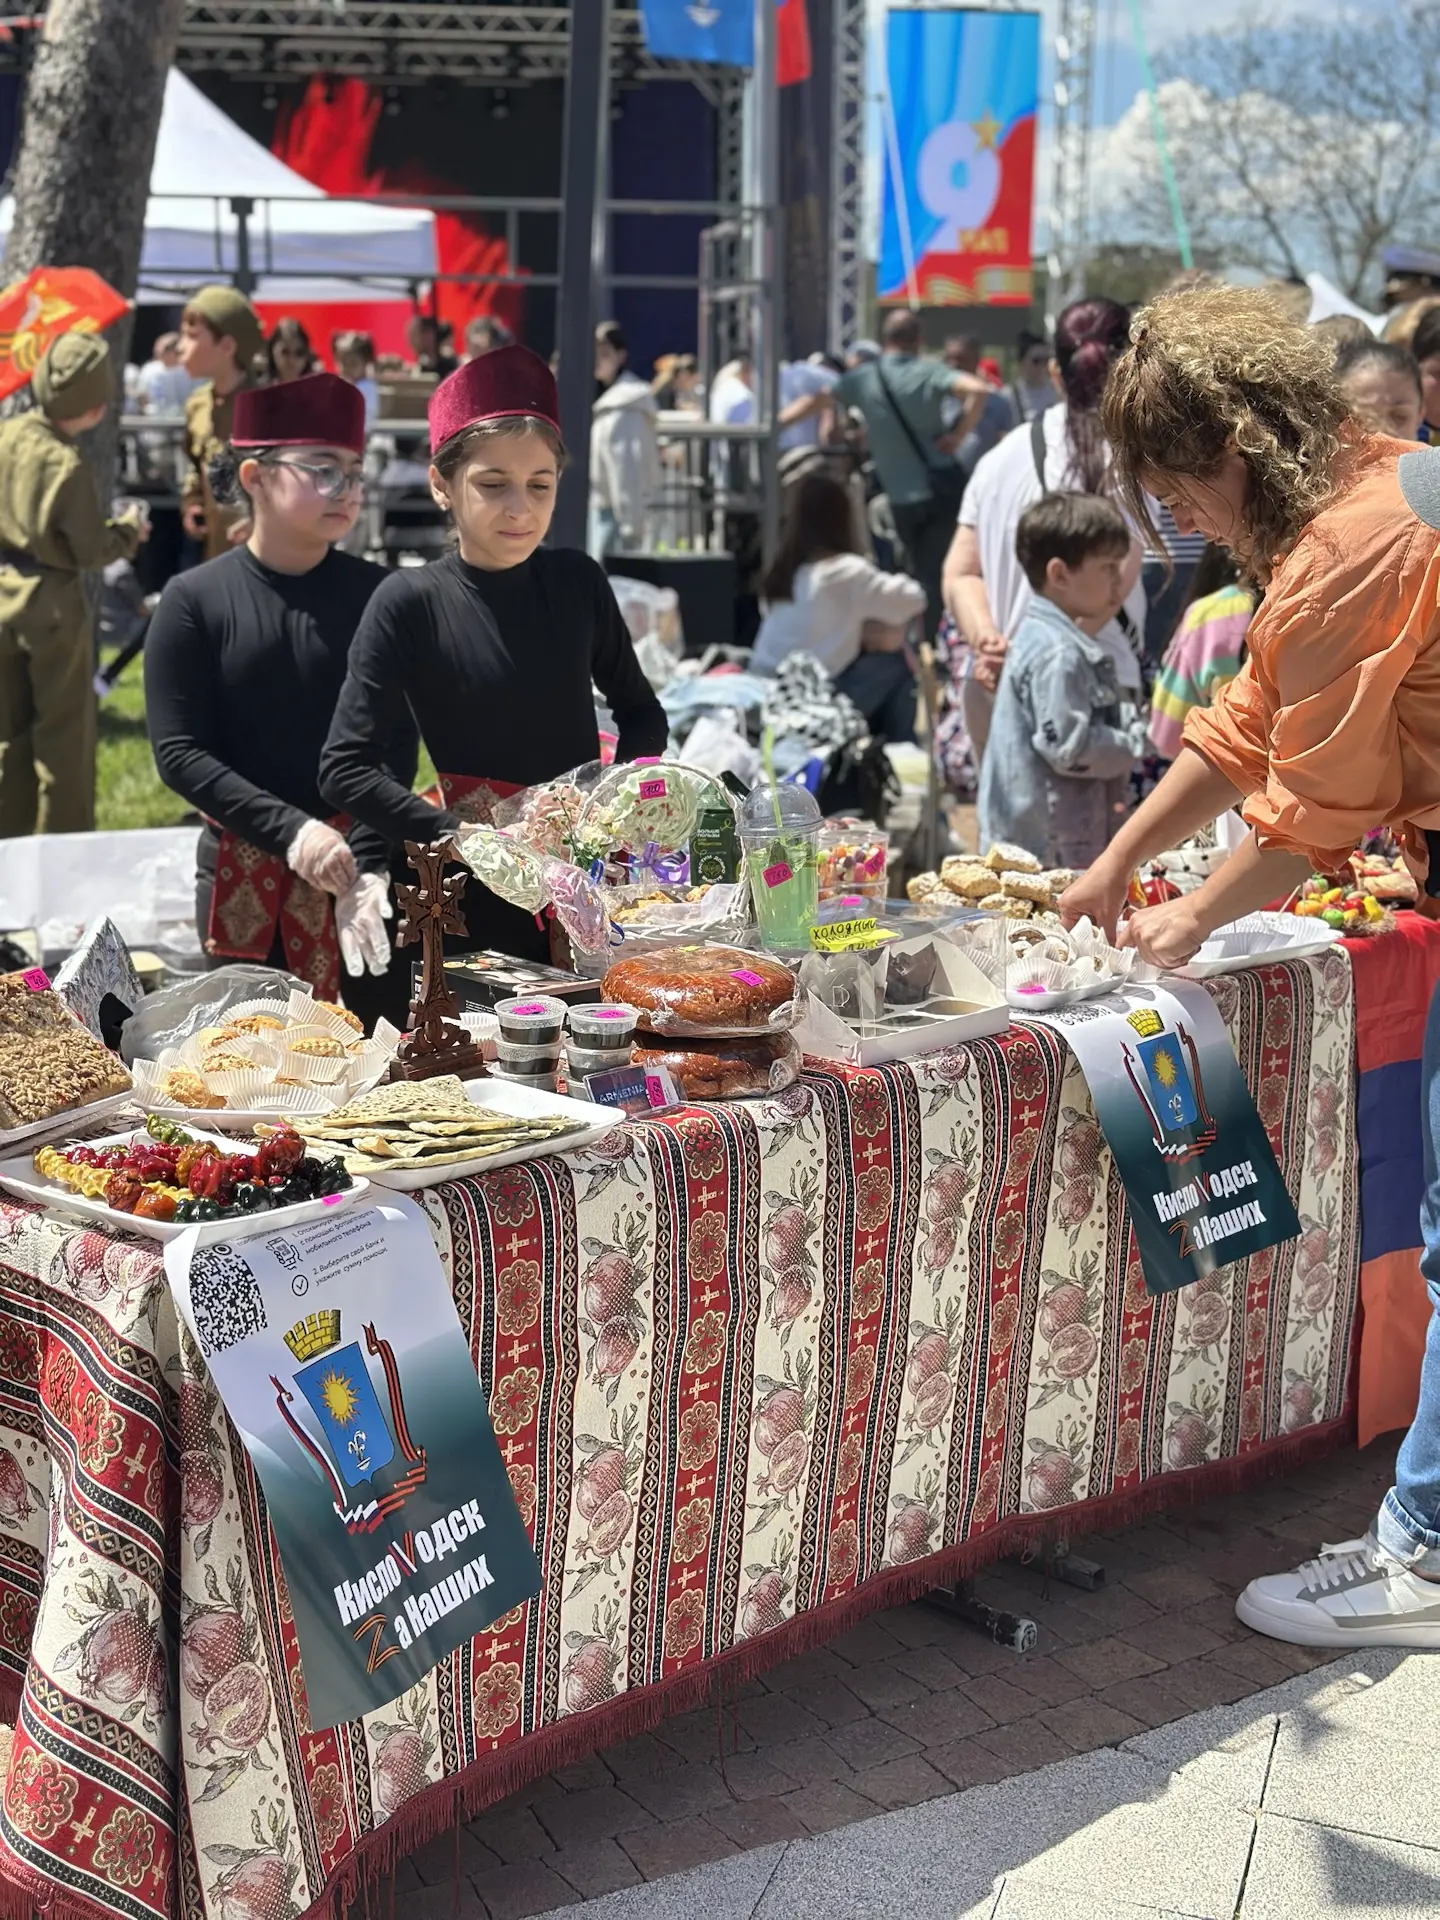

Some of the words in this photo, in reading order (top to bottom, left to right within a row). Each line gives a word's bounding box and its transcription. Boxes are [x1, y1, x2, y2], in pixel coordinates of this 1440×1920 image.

[916, 119, 1003, 253] 9
[599, 1083, 646, 1104] ARMENIA
[305, 1234, 343, 1255] мобильного
[342, 1220, 372, 1239] телефона
[1199, 1199, 1267, 1246] Наших
[315, 1269, 341, 1286] укажите
[343, 1259, 362, 1273] сумму
[319, 1253, 350, 1272] Выберите
[350, 1245, 365, 1258] свой
[365, 1239, 380, 1250] банк
[402, 1553, 495, 1638] Наших
